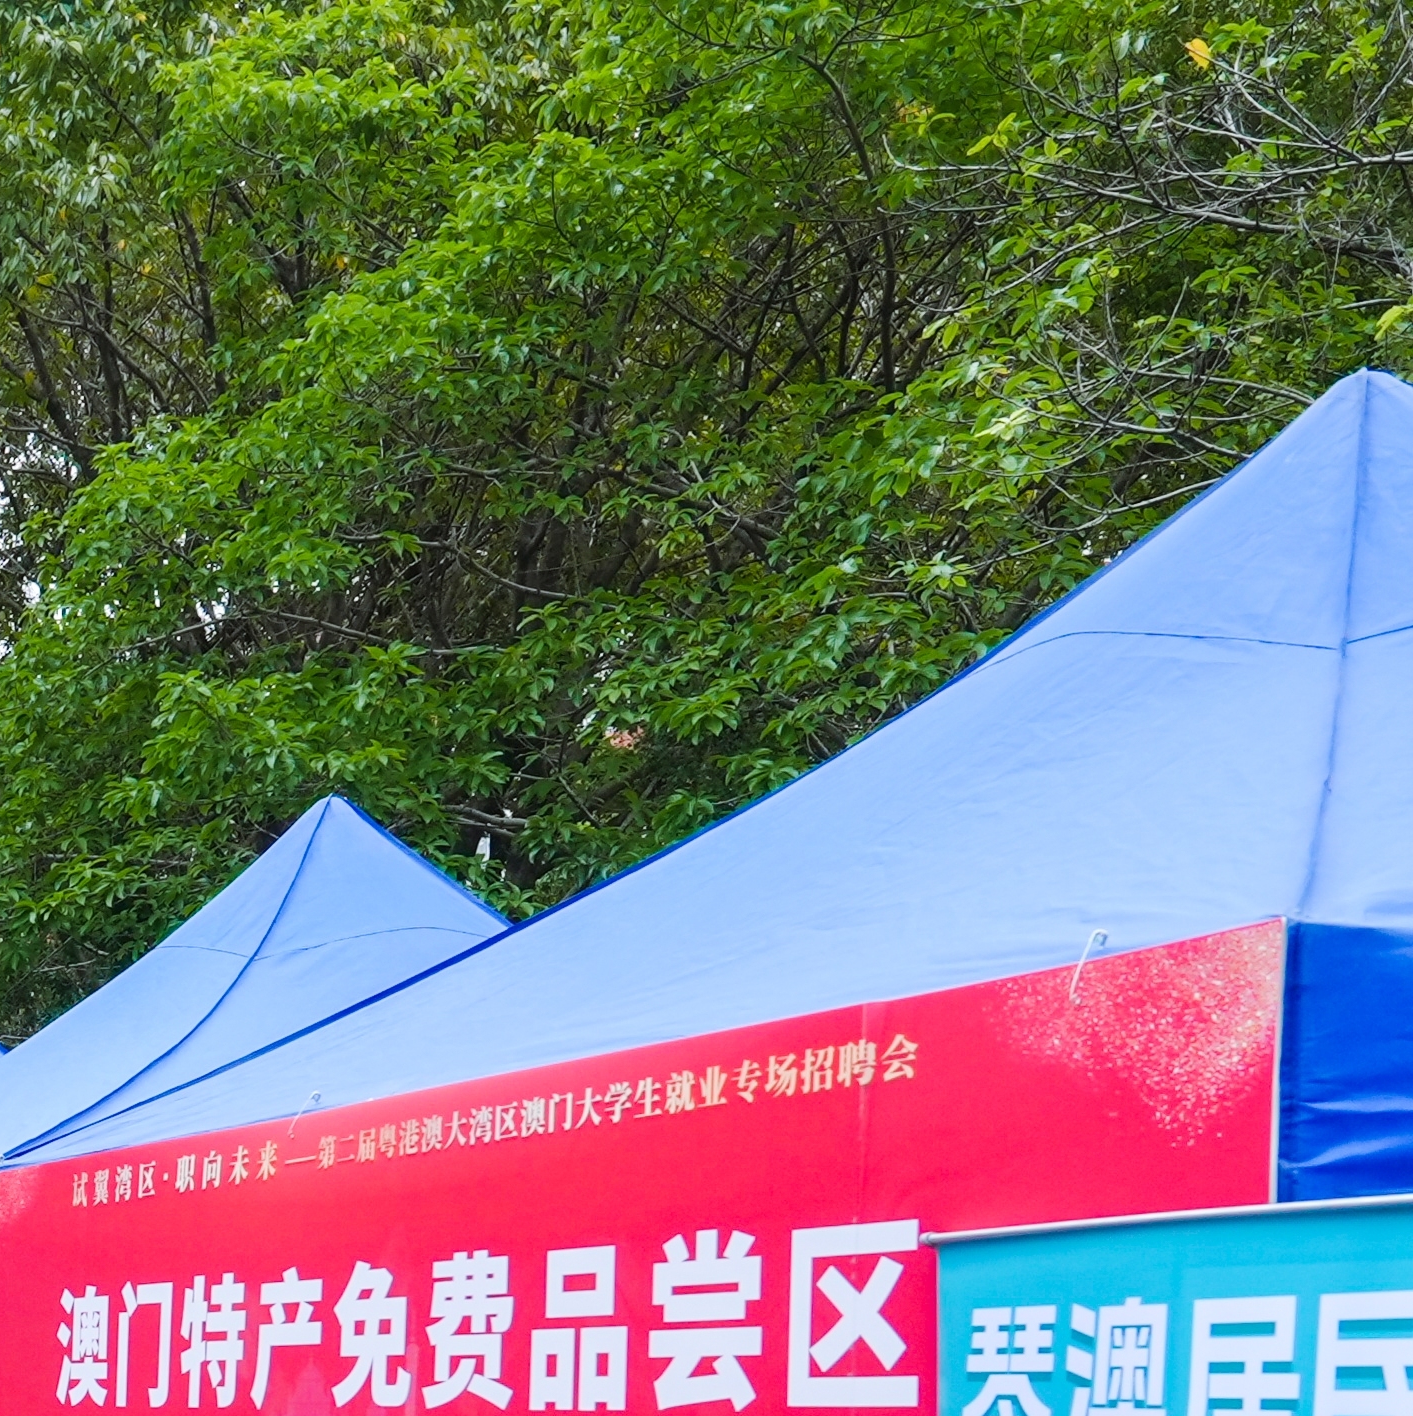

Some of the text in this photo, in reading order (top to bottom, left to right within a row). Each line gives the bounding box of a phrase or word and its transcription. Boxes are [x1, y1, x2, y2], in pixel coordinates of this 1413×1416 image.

[56, 1219, 920, 1412] 澳门特产免费品尝区
